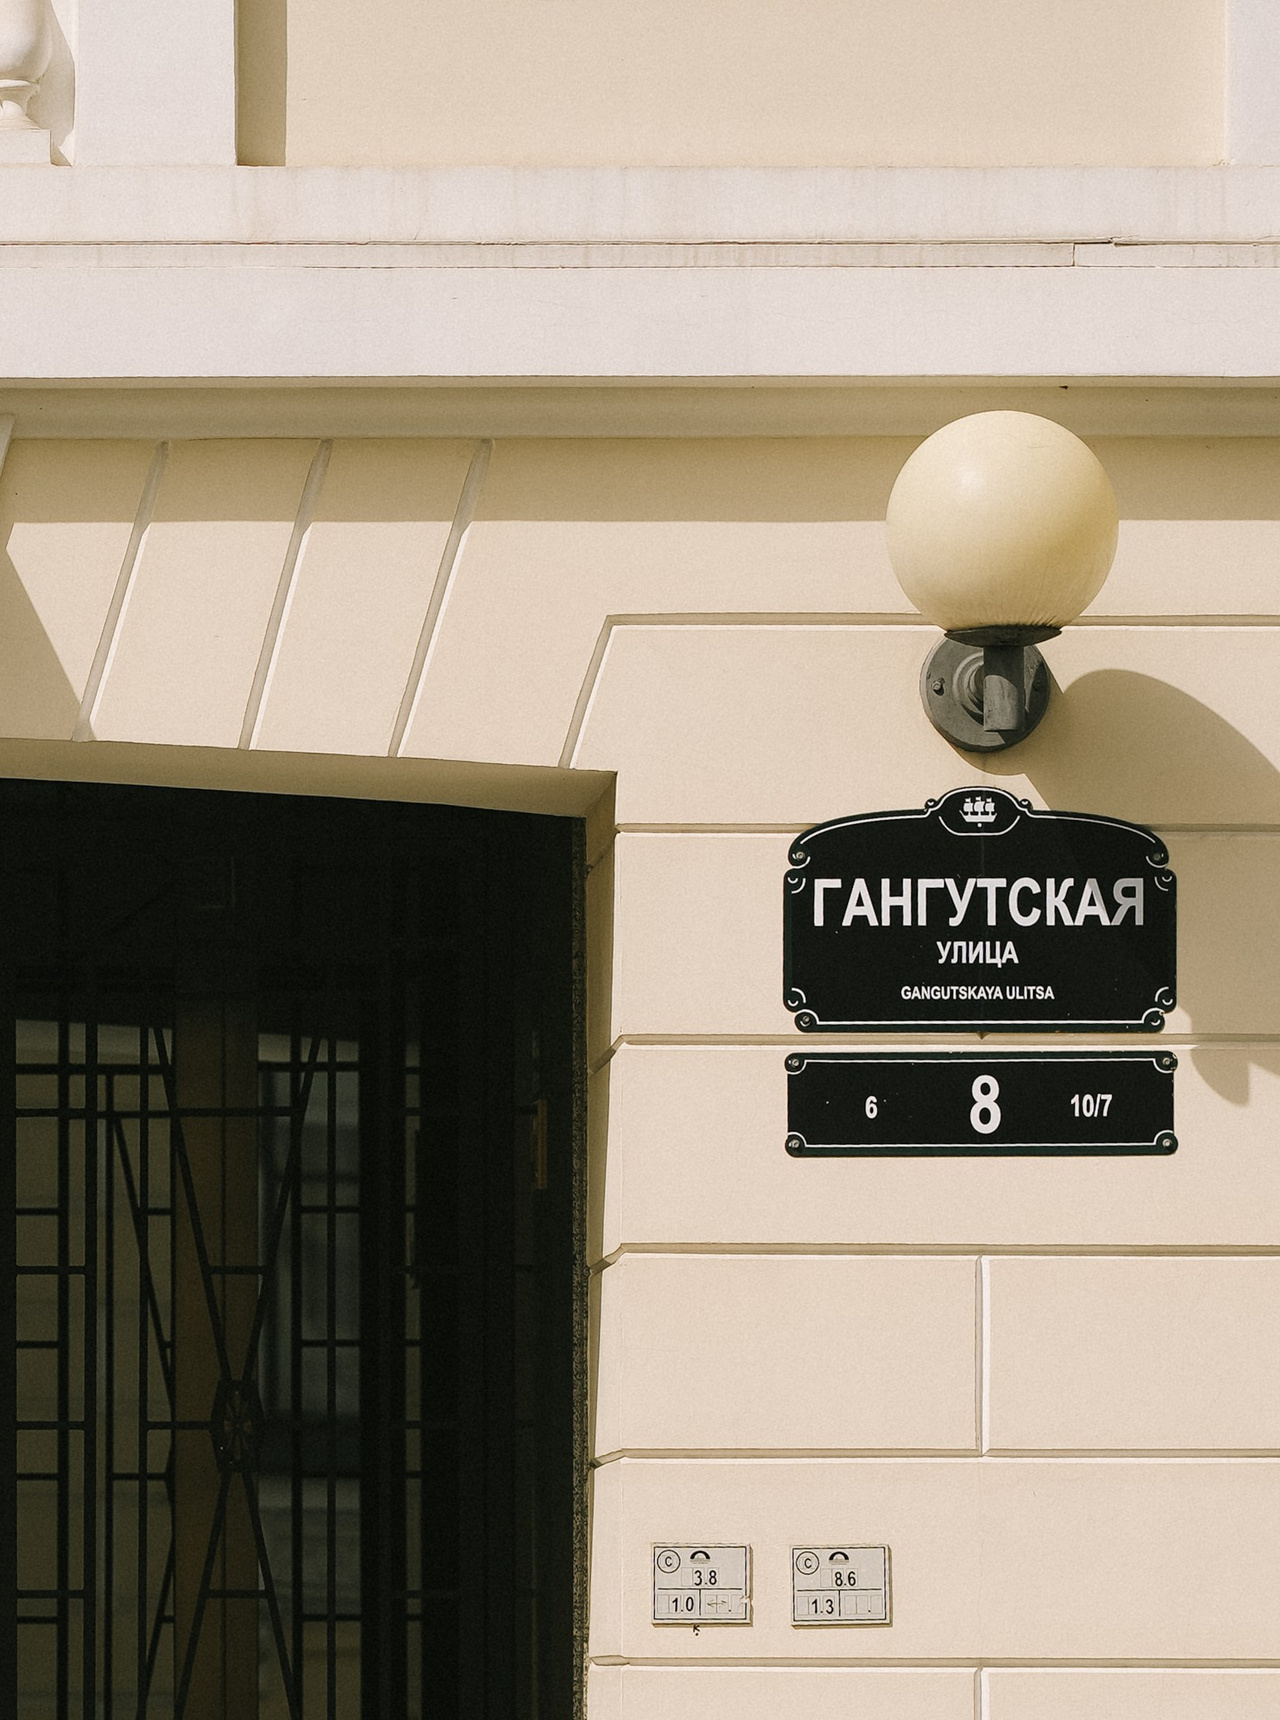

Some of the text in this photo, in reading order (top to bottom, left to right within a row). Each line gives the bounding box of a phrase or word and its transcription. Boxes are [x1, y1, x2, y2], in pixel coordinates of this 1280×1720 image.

[813, 877, 1144, 927] ГАНГУТСКАЯ
[936, 940, 1019, 968] УЛИЦА
[901, 985, 1055, 1000] GANGUTSKAYA ULITSA
[865, 1074, 1113, 1134] 6 8 10/7
[694, 1570, 717, 1586] 3.8
[834, 1571, 857, 1587] 8.6
[672, 1596, 694, 1613] 1.0
[811, 1598, 834, 1615] 1.3
